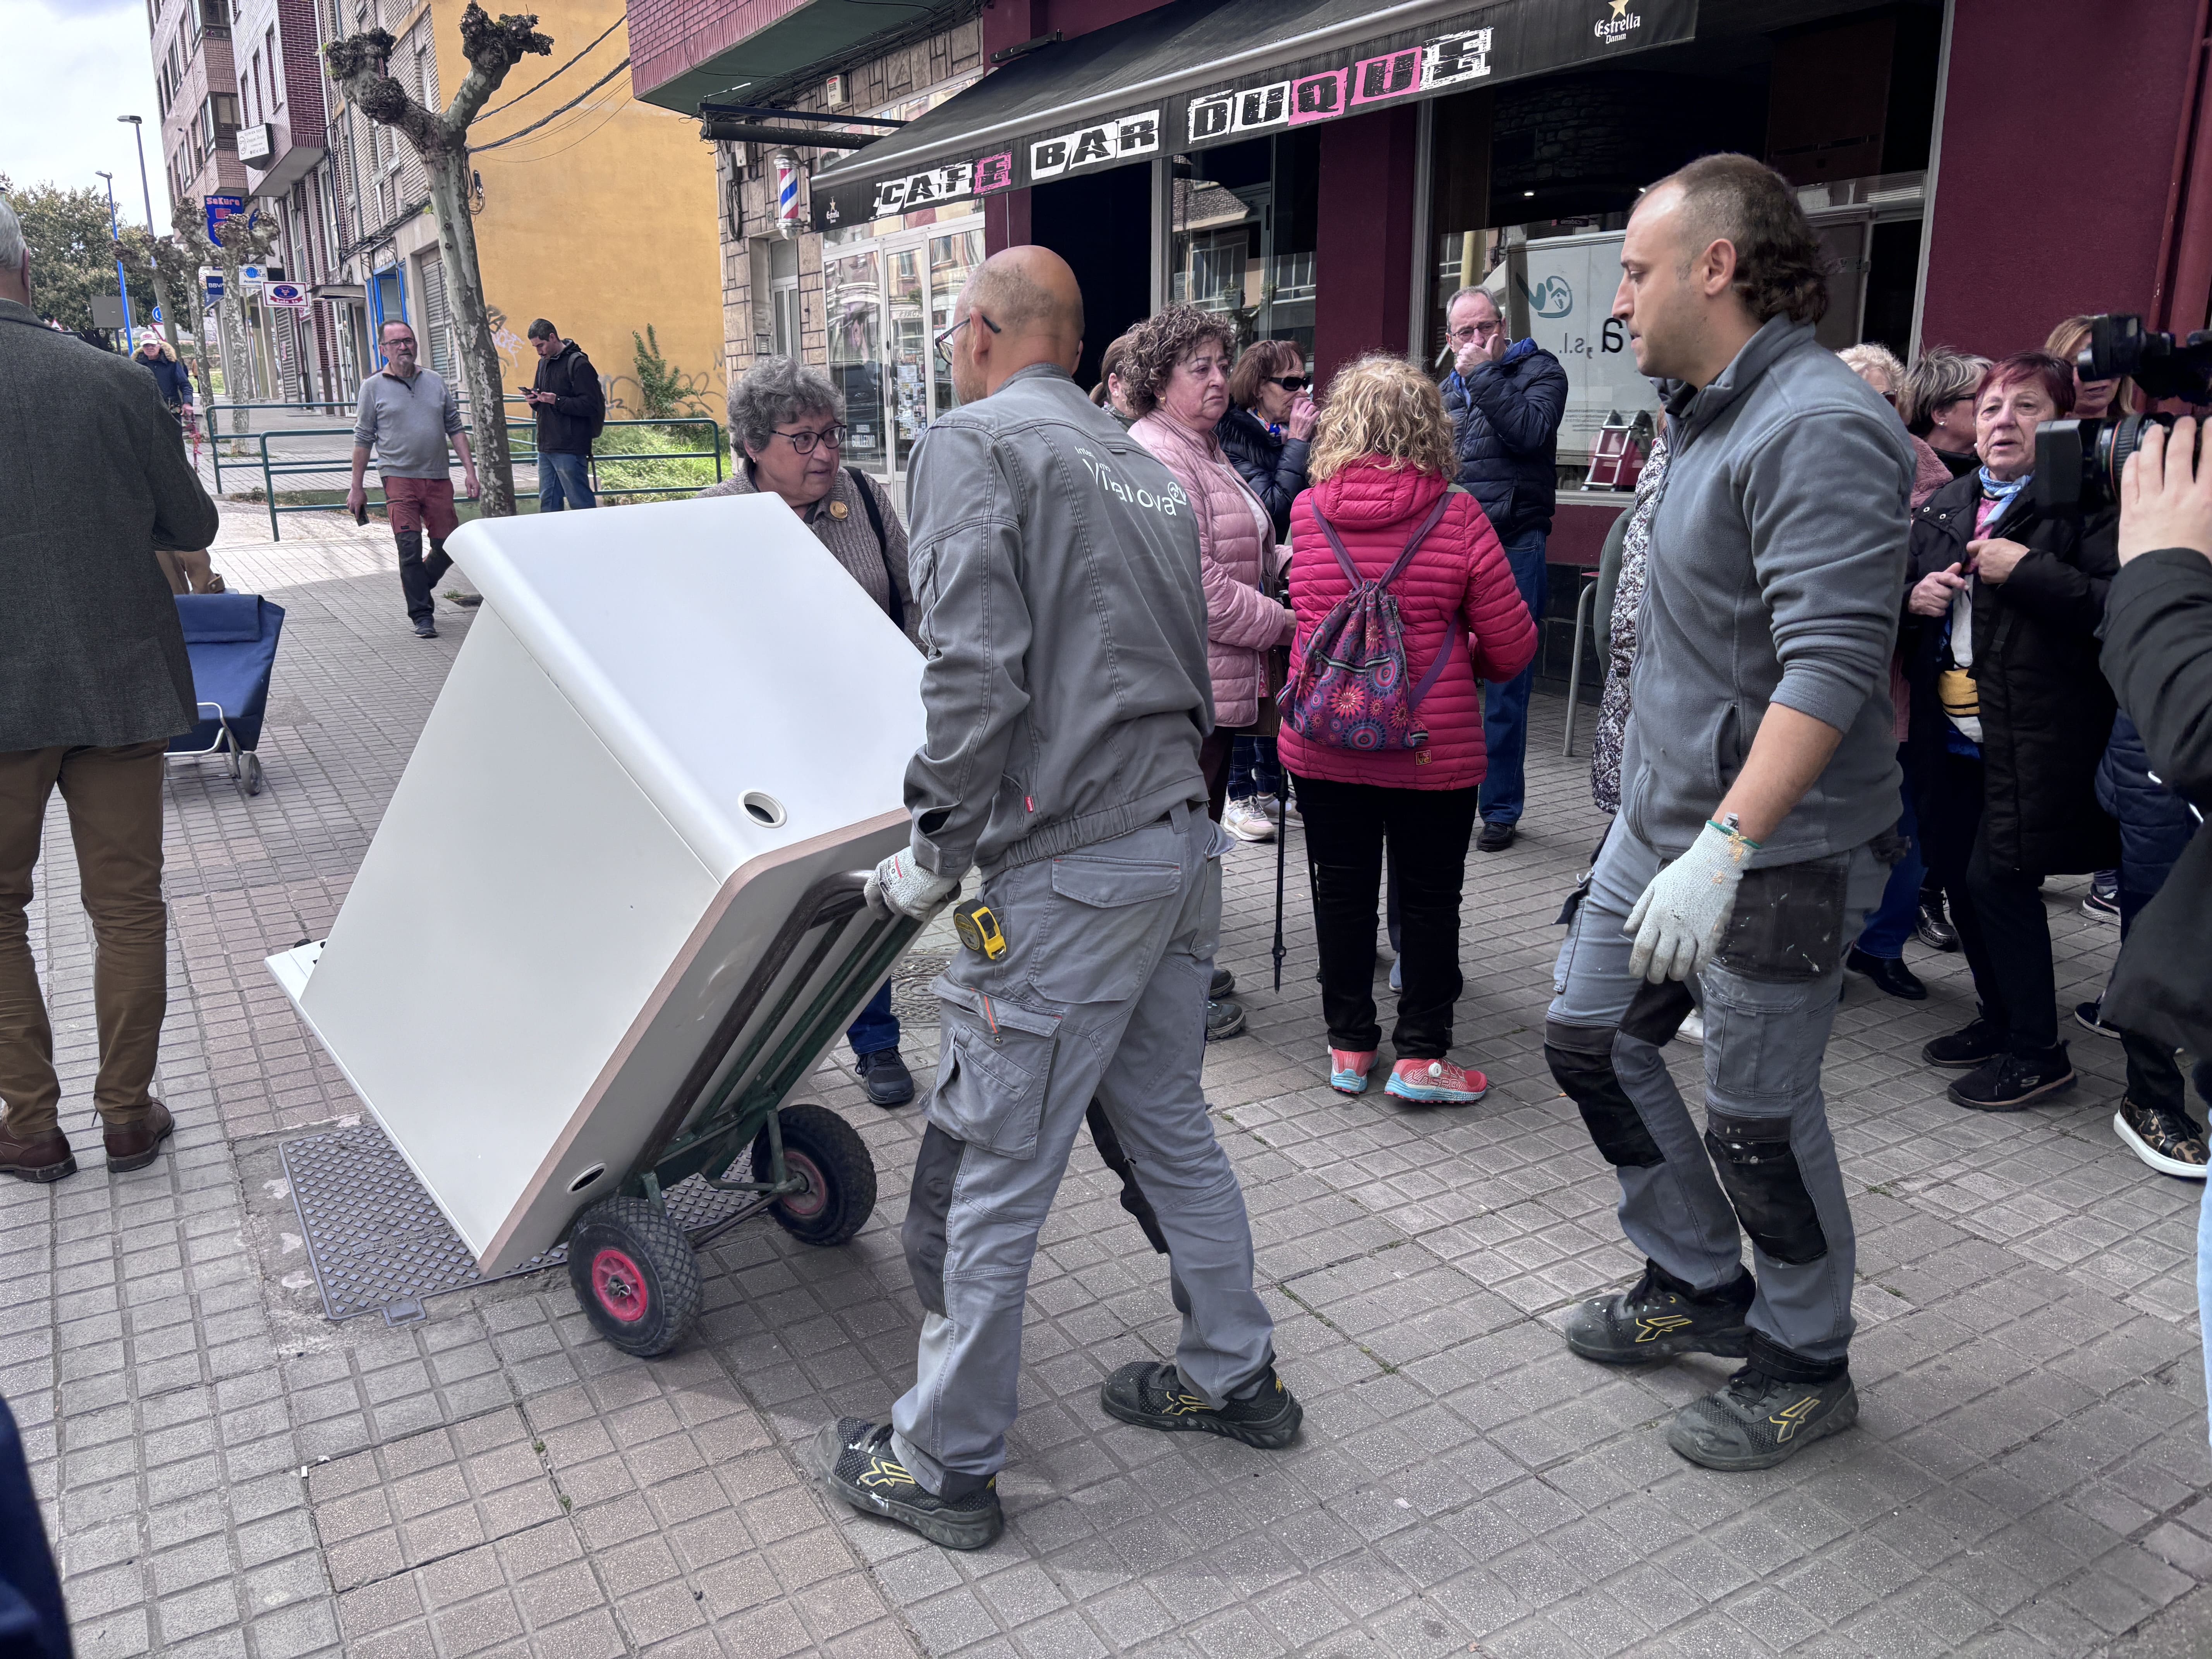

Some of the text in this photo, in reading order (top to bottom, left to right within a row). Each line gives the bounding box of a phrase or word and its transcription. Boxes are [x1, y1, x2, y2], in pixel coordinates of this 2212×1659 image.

[1594, 12, 1640, 37] Estrella
[1606, 33, 1626, 44] Damm
[1030, 110, 1159, 180] BAR
[1188, 27, 1494, 144] DUQUE
